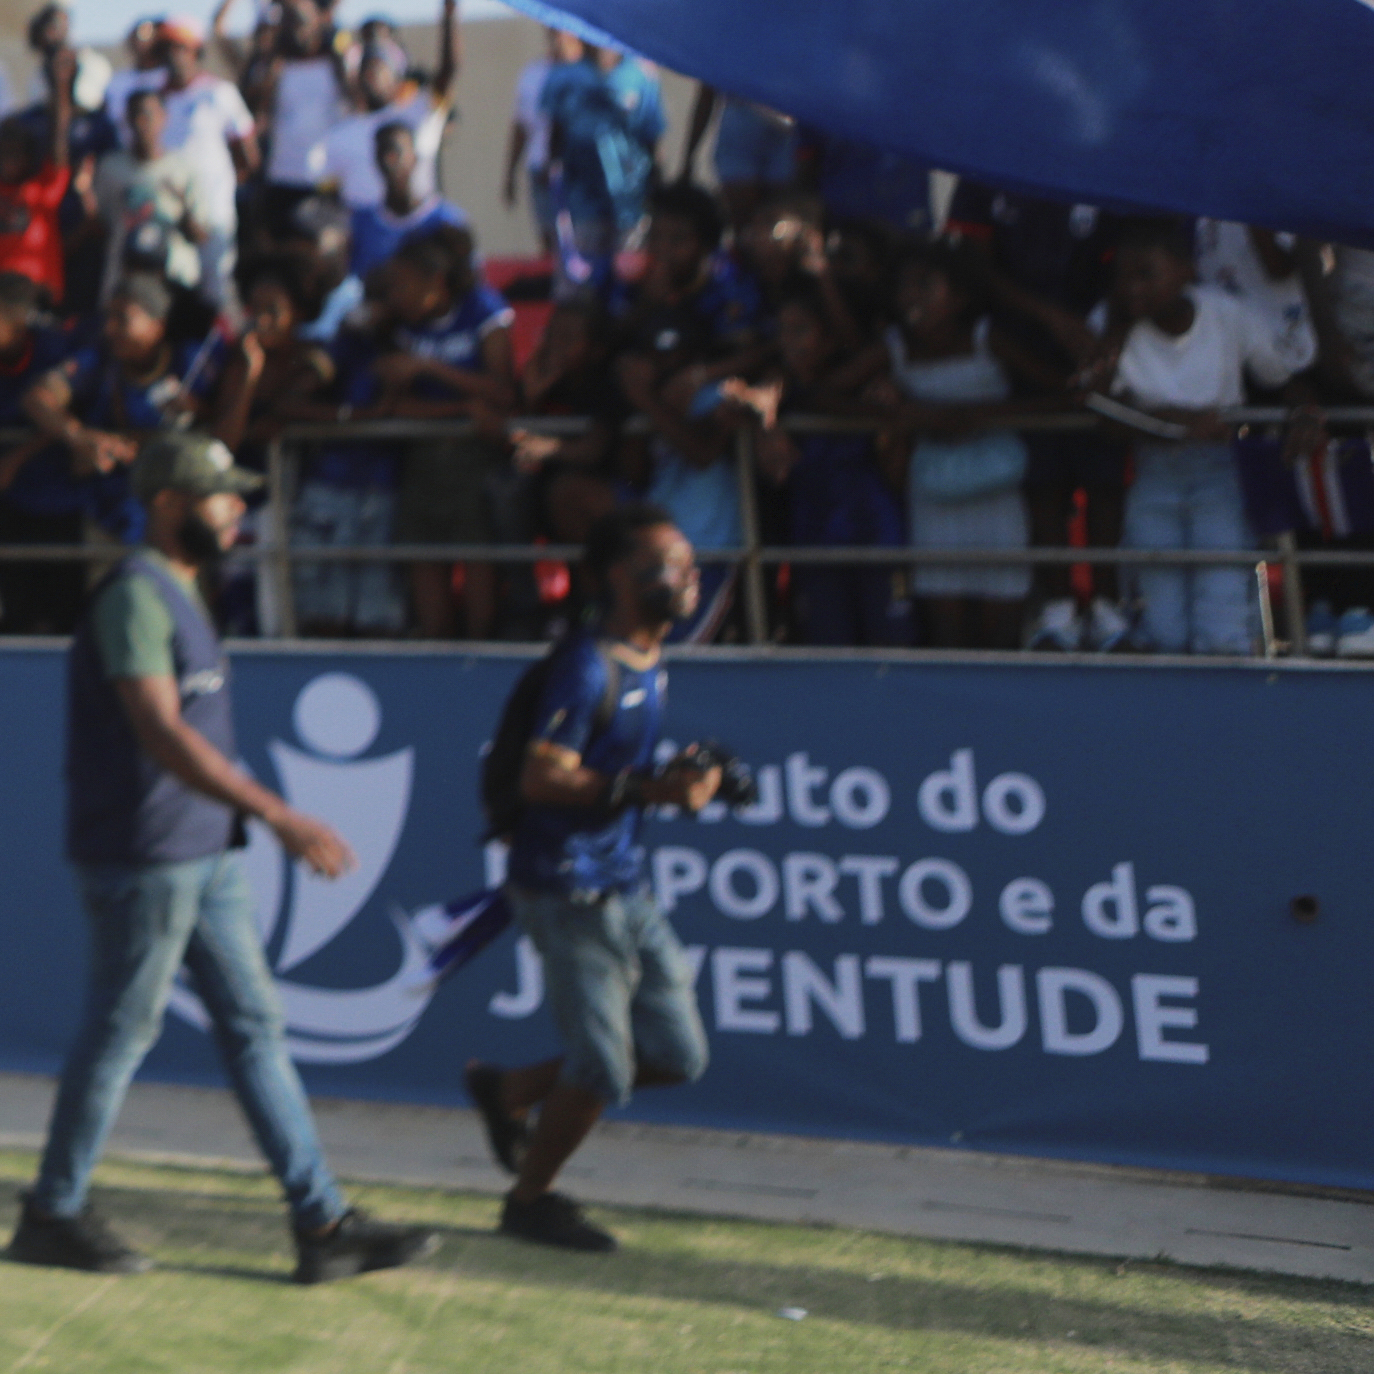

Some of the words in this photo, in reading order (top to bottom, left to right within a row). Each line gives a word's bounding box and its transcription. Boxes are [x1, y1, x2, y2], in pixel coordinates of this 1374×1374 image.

[917, 748, 1047, 836] do
[998, 876, 1056, 935] e
[1080, 860, 1198, 944] da
[488, 934, 1211, 1066] JENTUDE
